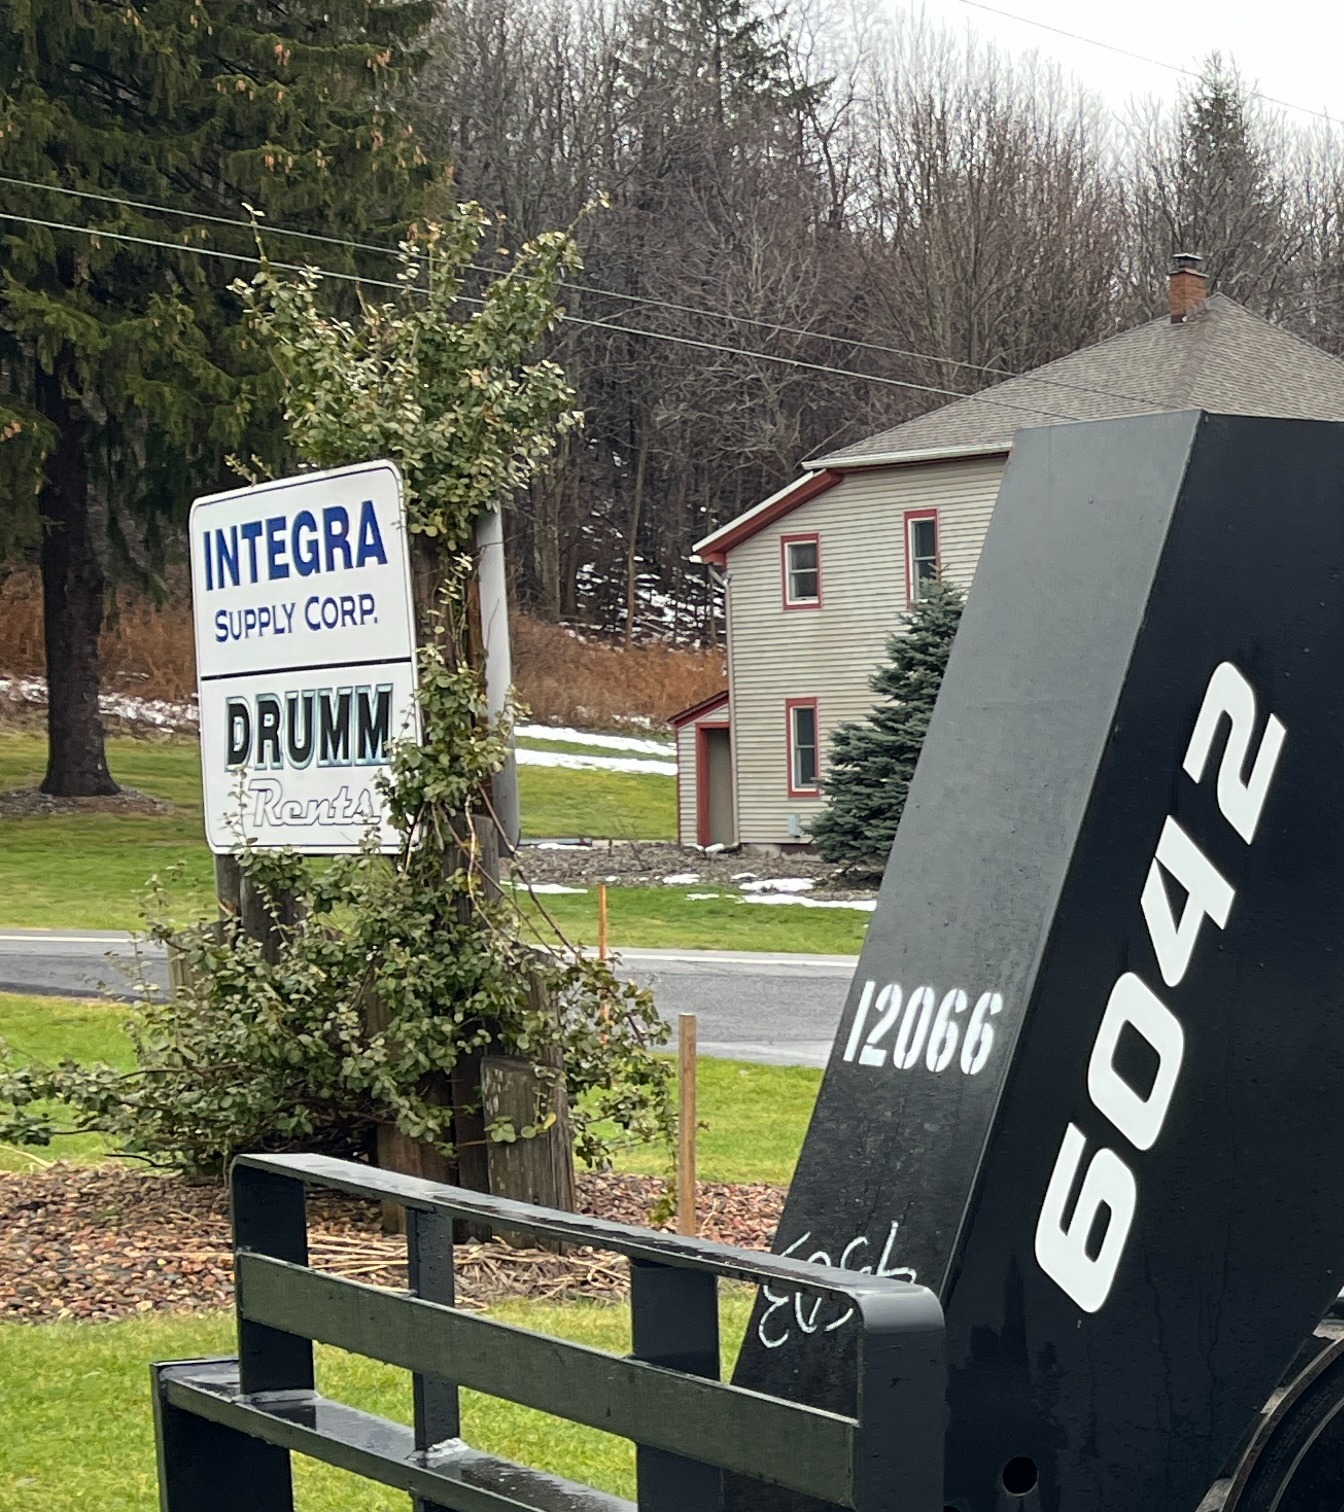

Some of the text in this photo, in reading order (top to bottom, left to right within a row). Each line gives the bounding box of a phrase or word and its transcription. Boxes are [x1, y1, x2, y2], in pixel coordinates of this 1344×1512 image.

[202, 500, 388, 591] INTEGRA
[214, 593, 379, 643] SUPPLY CORP.
[224, 683, 394, 772] DRUMM
[247, 777, 383, 828] Rents
[843, 980, 1002, 1075] 12066
[1035, 661, 1287, 1314] 6042
